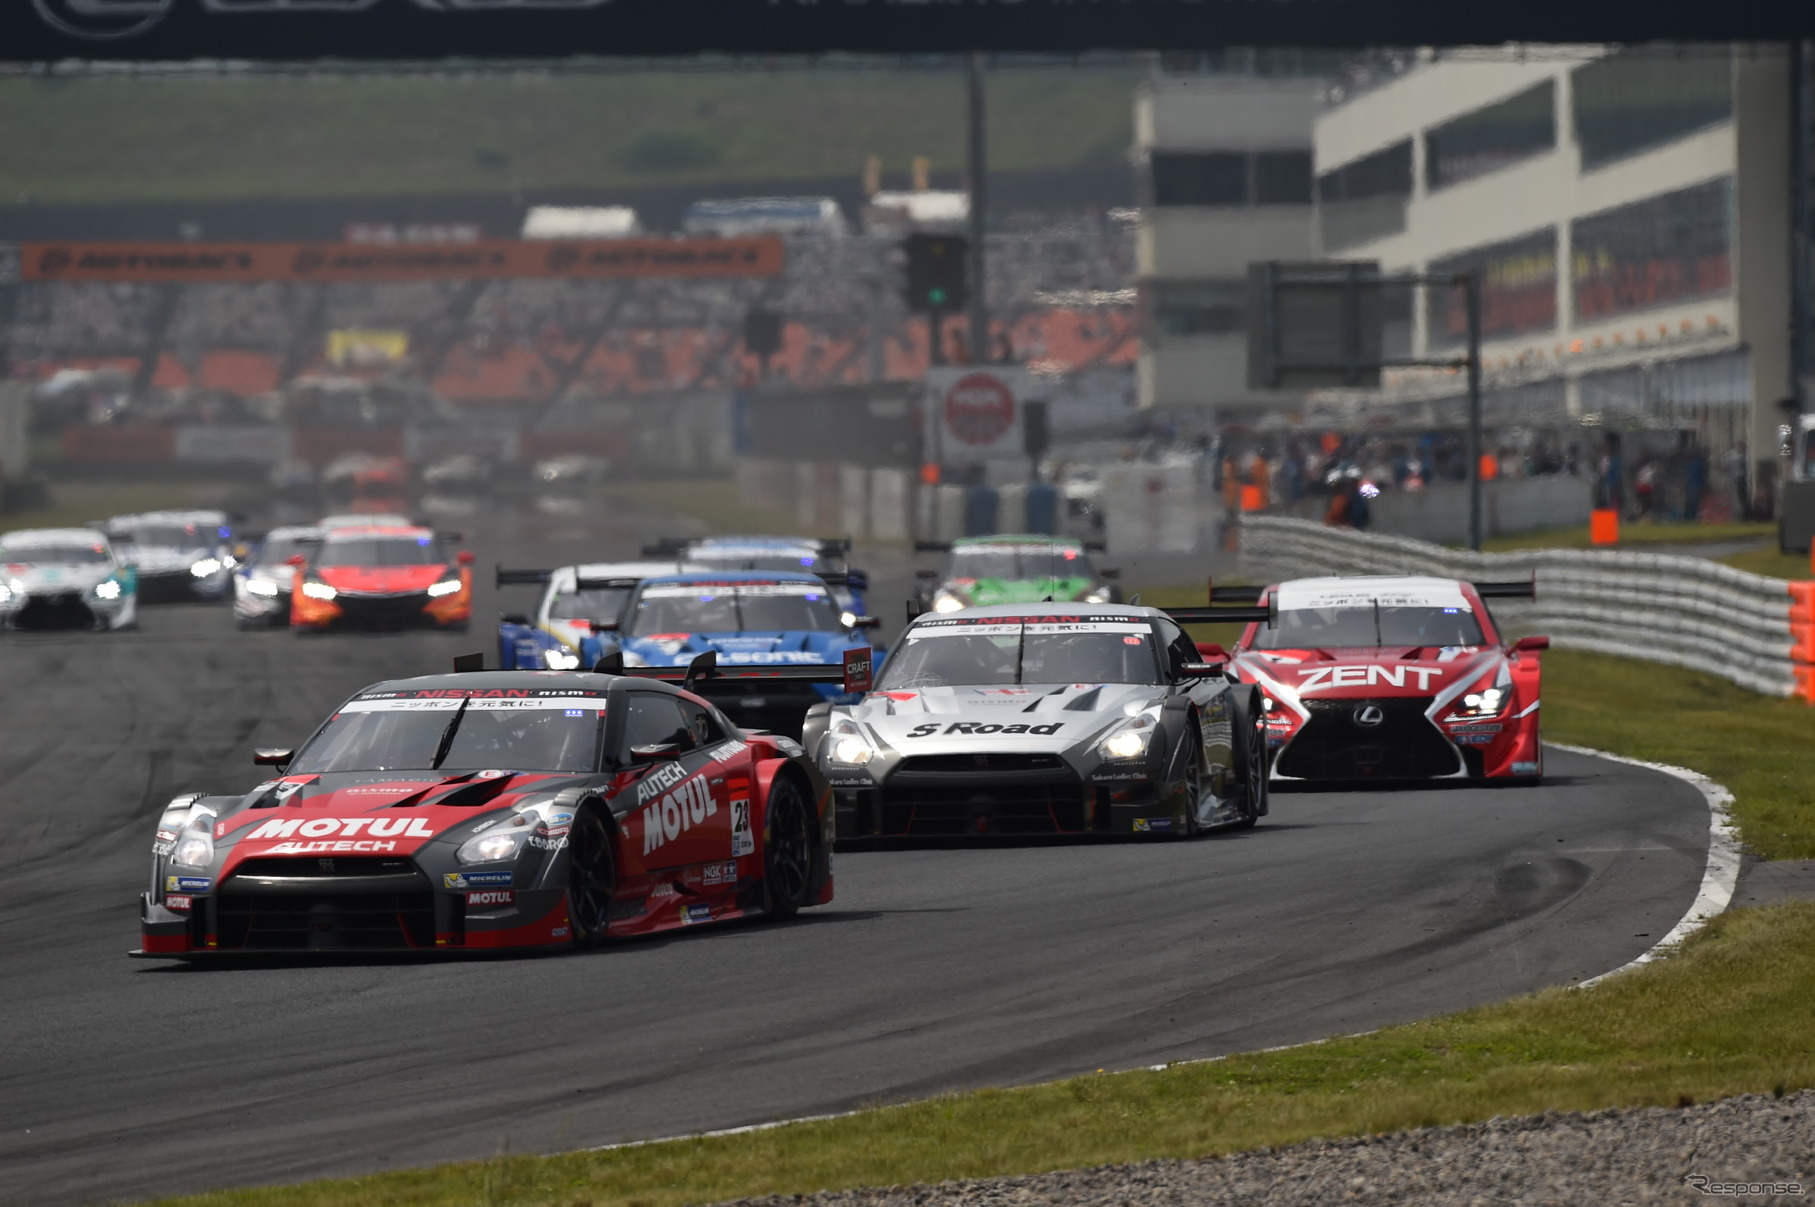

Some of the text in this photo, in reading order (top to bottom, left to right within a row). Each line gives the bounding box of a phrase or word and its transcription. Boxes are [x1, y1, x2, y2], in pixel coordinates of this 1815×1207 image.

[974, 616, 1081, 625] NISSAN
[846, 660, 871, 675] CRAFT
[1297, 665, 1443, 694] ZENT
[415, 689, 530, 699] NISSAN
[907, 722, 1067, 738] S Road
[637, 760, 688, 806] AUTECH
[643, 773, 718, 856] MOTUL
[734, 800, 749, 833] 23
[245, 817, 434, 839] MOTUL
[264, 840, 397, 854] AUTECH
[703, 864, 722, 878] NGK
[166, 896, 191, 909] MOTUL
[468, 892, 512, 904] MOTUL
